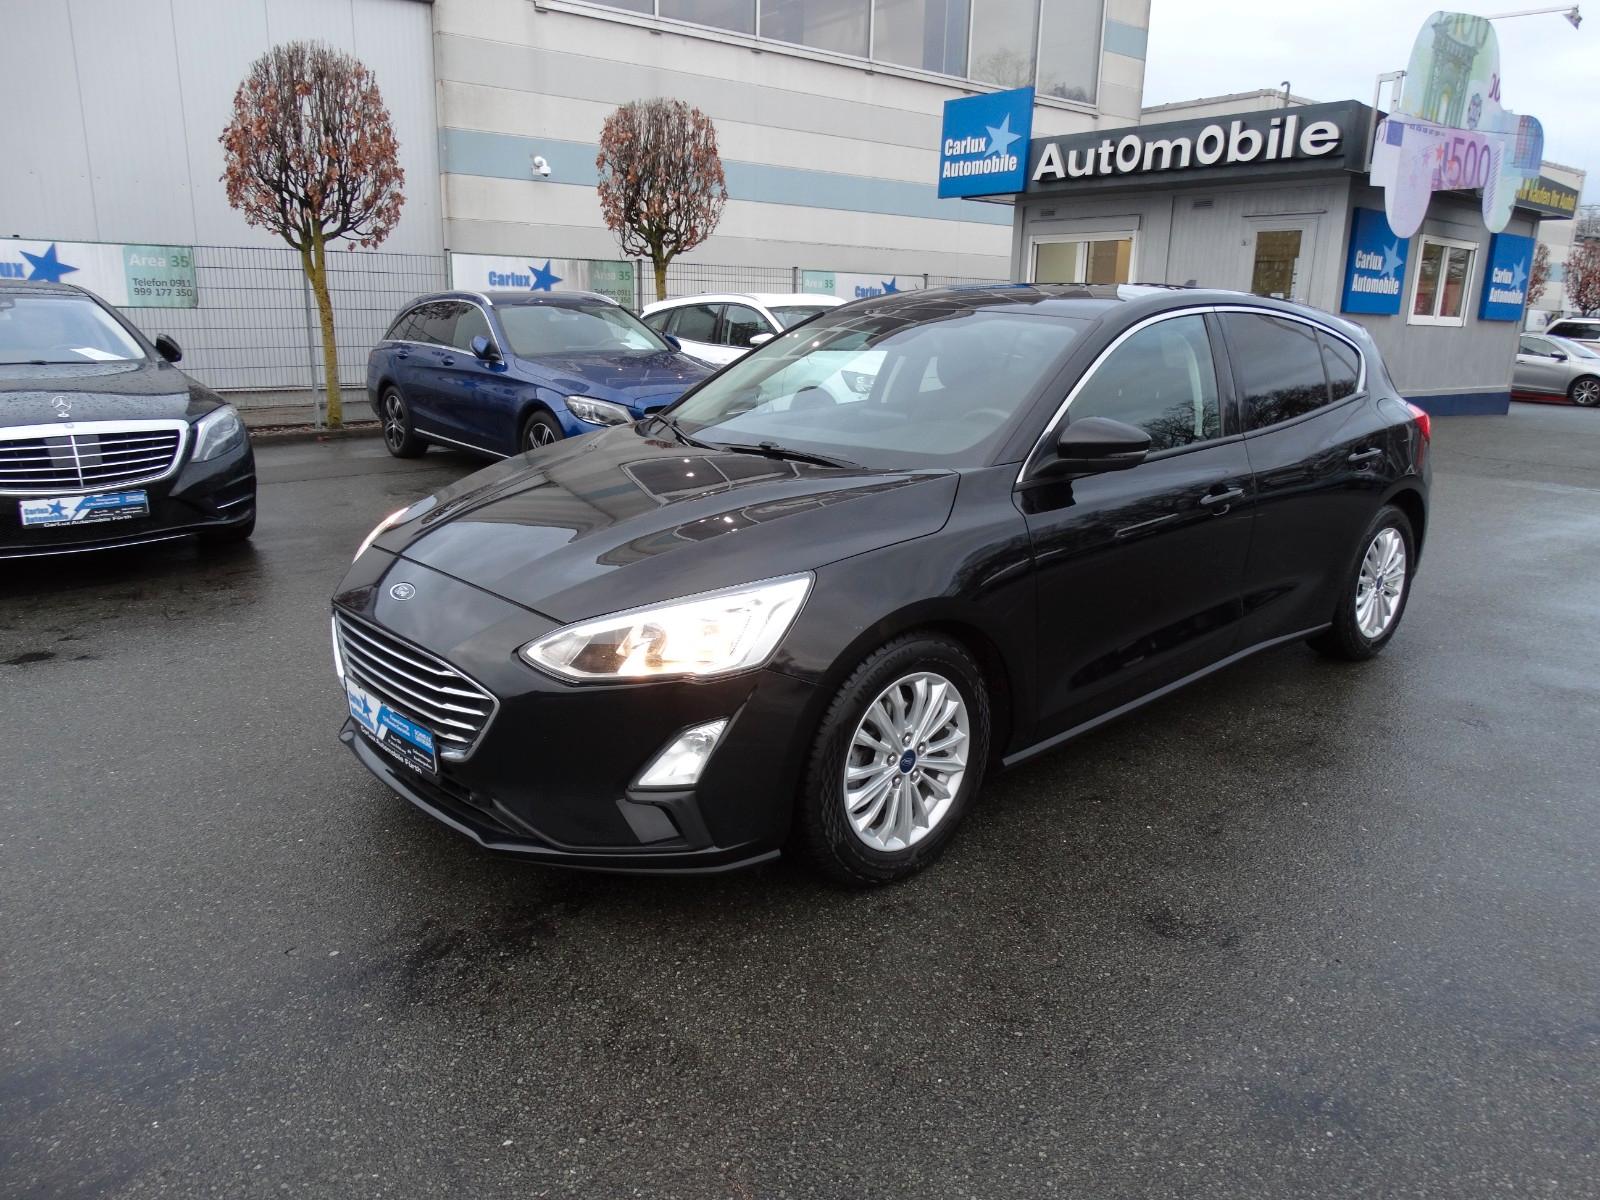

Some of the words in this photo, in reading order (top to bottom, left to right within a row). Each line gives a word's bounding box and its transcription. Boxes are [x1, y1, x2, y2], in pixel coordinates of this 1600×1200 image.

[944, 136, 987, 156] Carlux
[942, 154, 1018, 178] Automobile
[1450, 137, 1491, 188] 500
[129, 254, 167, 267] Area
[170, 255, 191, 268] 35
[1355, 250, 1383, 271] Carlux
[132, 278, 168, 288] Telefon
[169, 279, 192, 288] 0911
[488, 270, 531, 287] Carlux
[618, 270, 631, 281] 35
[824, 279, 834, 289] 35
[1352, 273, 1400, 295] Automobile
[1492, 267, 1513, 285] Carlux
[133, 287, 153, 296] 999
[155, 288, 172, 297] 177
[175, 288, 193, 297] 350
[617, 289, 631, 297] 0911
[1489, 287, 1523, 305] Automobile
